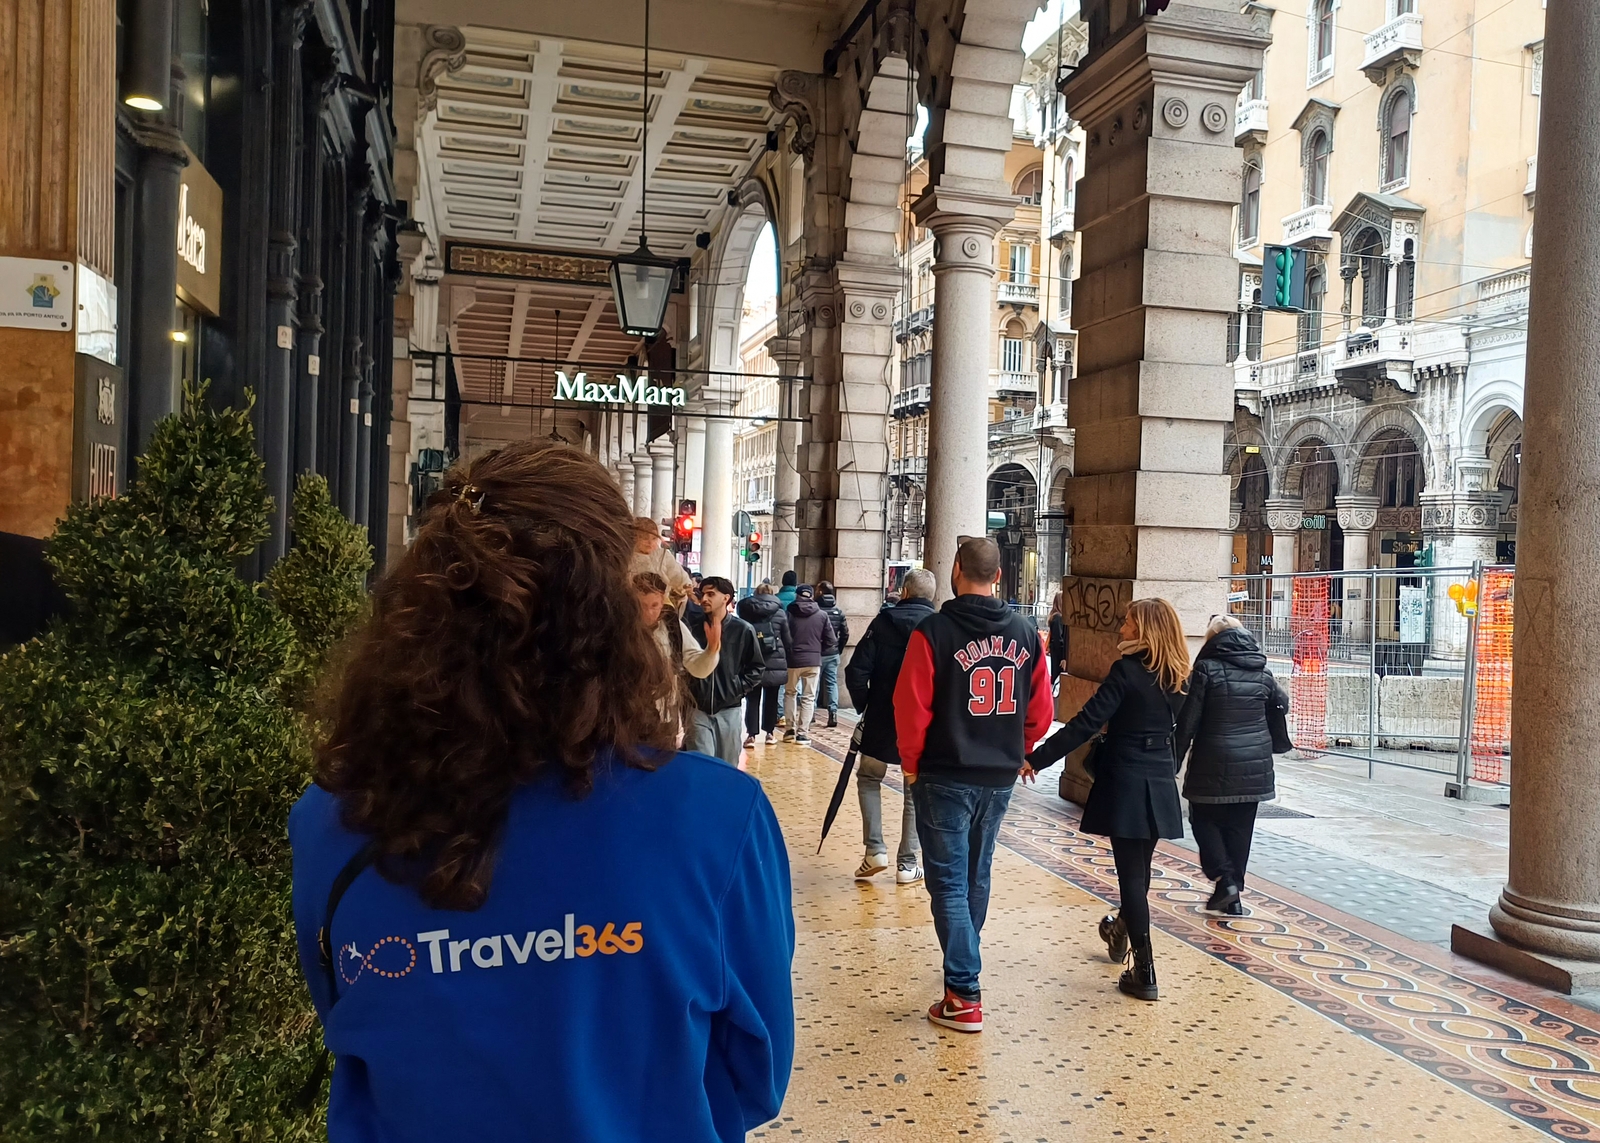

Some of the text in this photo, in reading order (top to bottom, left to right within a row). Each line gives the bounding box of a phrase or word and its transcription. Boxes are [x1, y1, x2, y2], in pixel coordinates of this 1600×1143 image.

[553, 371, 685, 406] MaxMara
[954, 635, 1030, 672] RODMAN
[968, 666, 1017, 716] 91
[417, 913, 643, 973] Travel365
